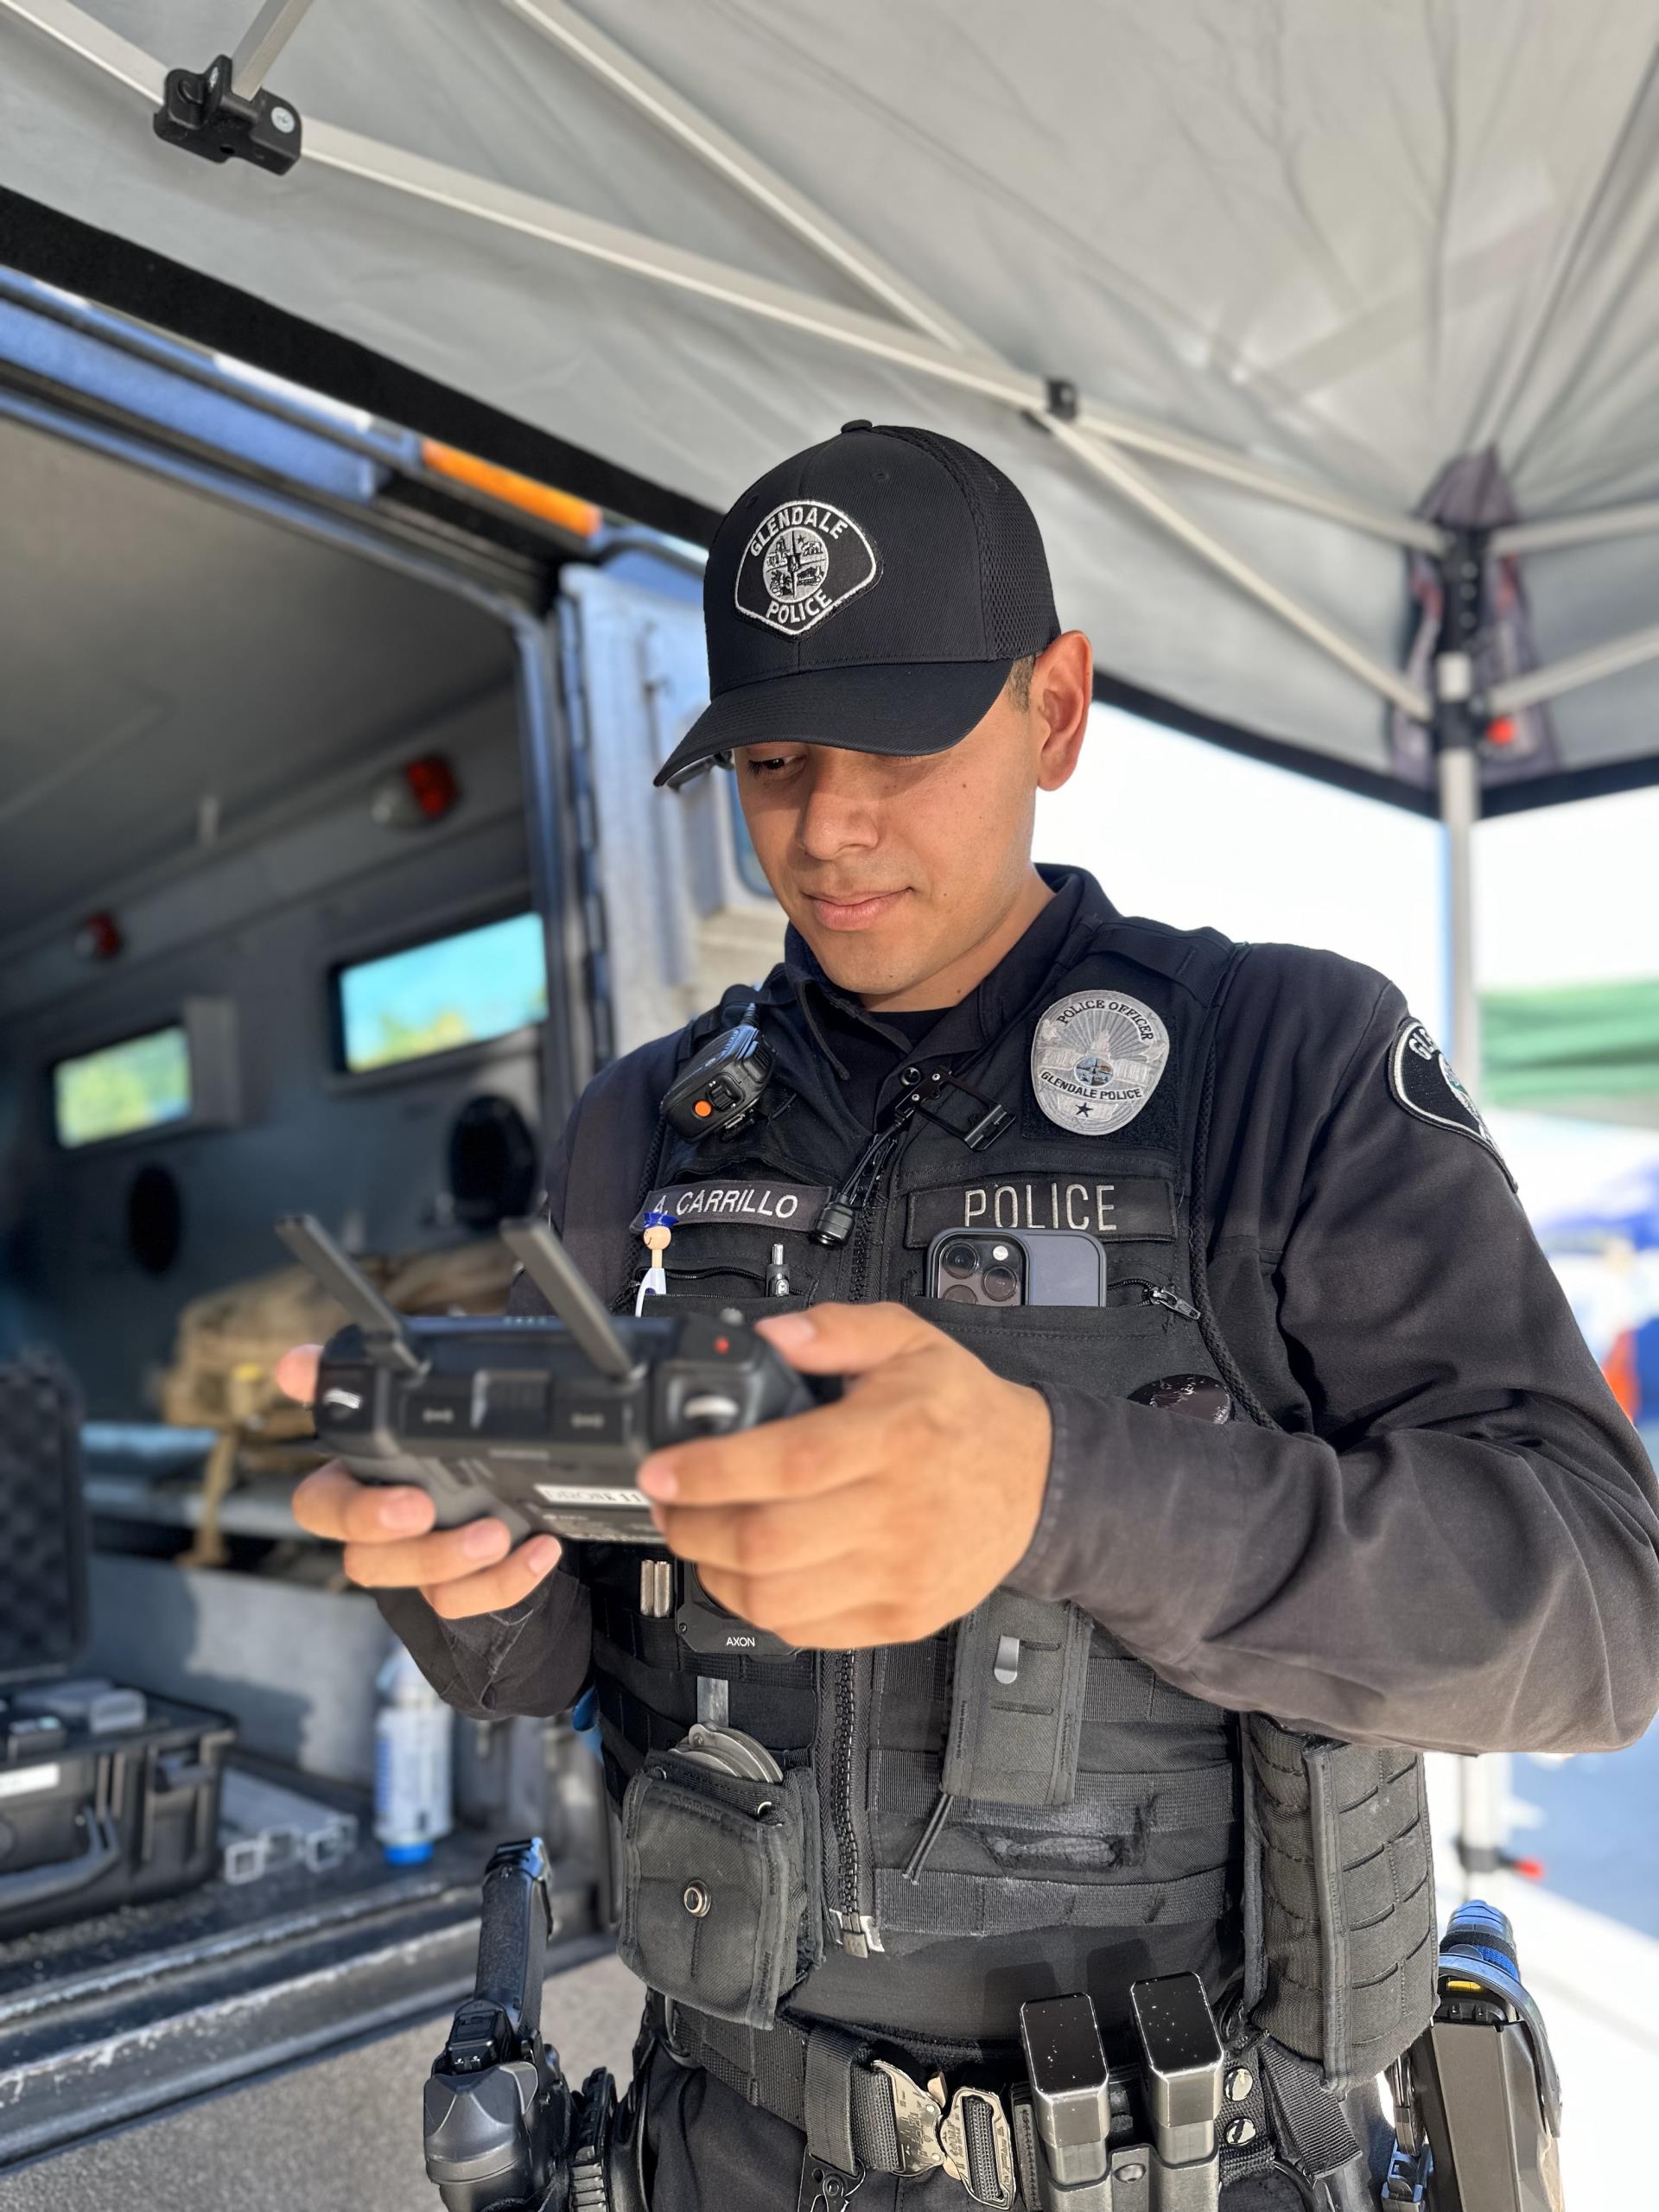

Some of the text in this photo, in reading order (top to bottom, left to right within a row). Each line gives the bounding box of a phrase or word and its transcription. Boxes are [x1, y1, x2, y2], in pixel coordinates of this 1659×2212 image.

[750, 506, 848, 557] GLENDALE
[766, 589, 832, 624] POLICE
[1057, 1000, 1154, 1041] POLICE OFFICER
[1040, 1071, 1142, 1100] GLENDALE POLICE
[676, 1189, 798, 1218] CARRILLO
[964, 1182, 1117, 1231] POLICE
[726, 1637, 756, 1647] AXON
